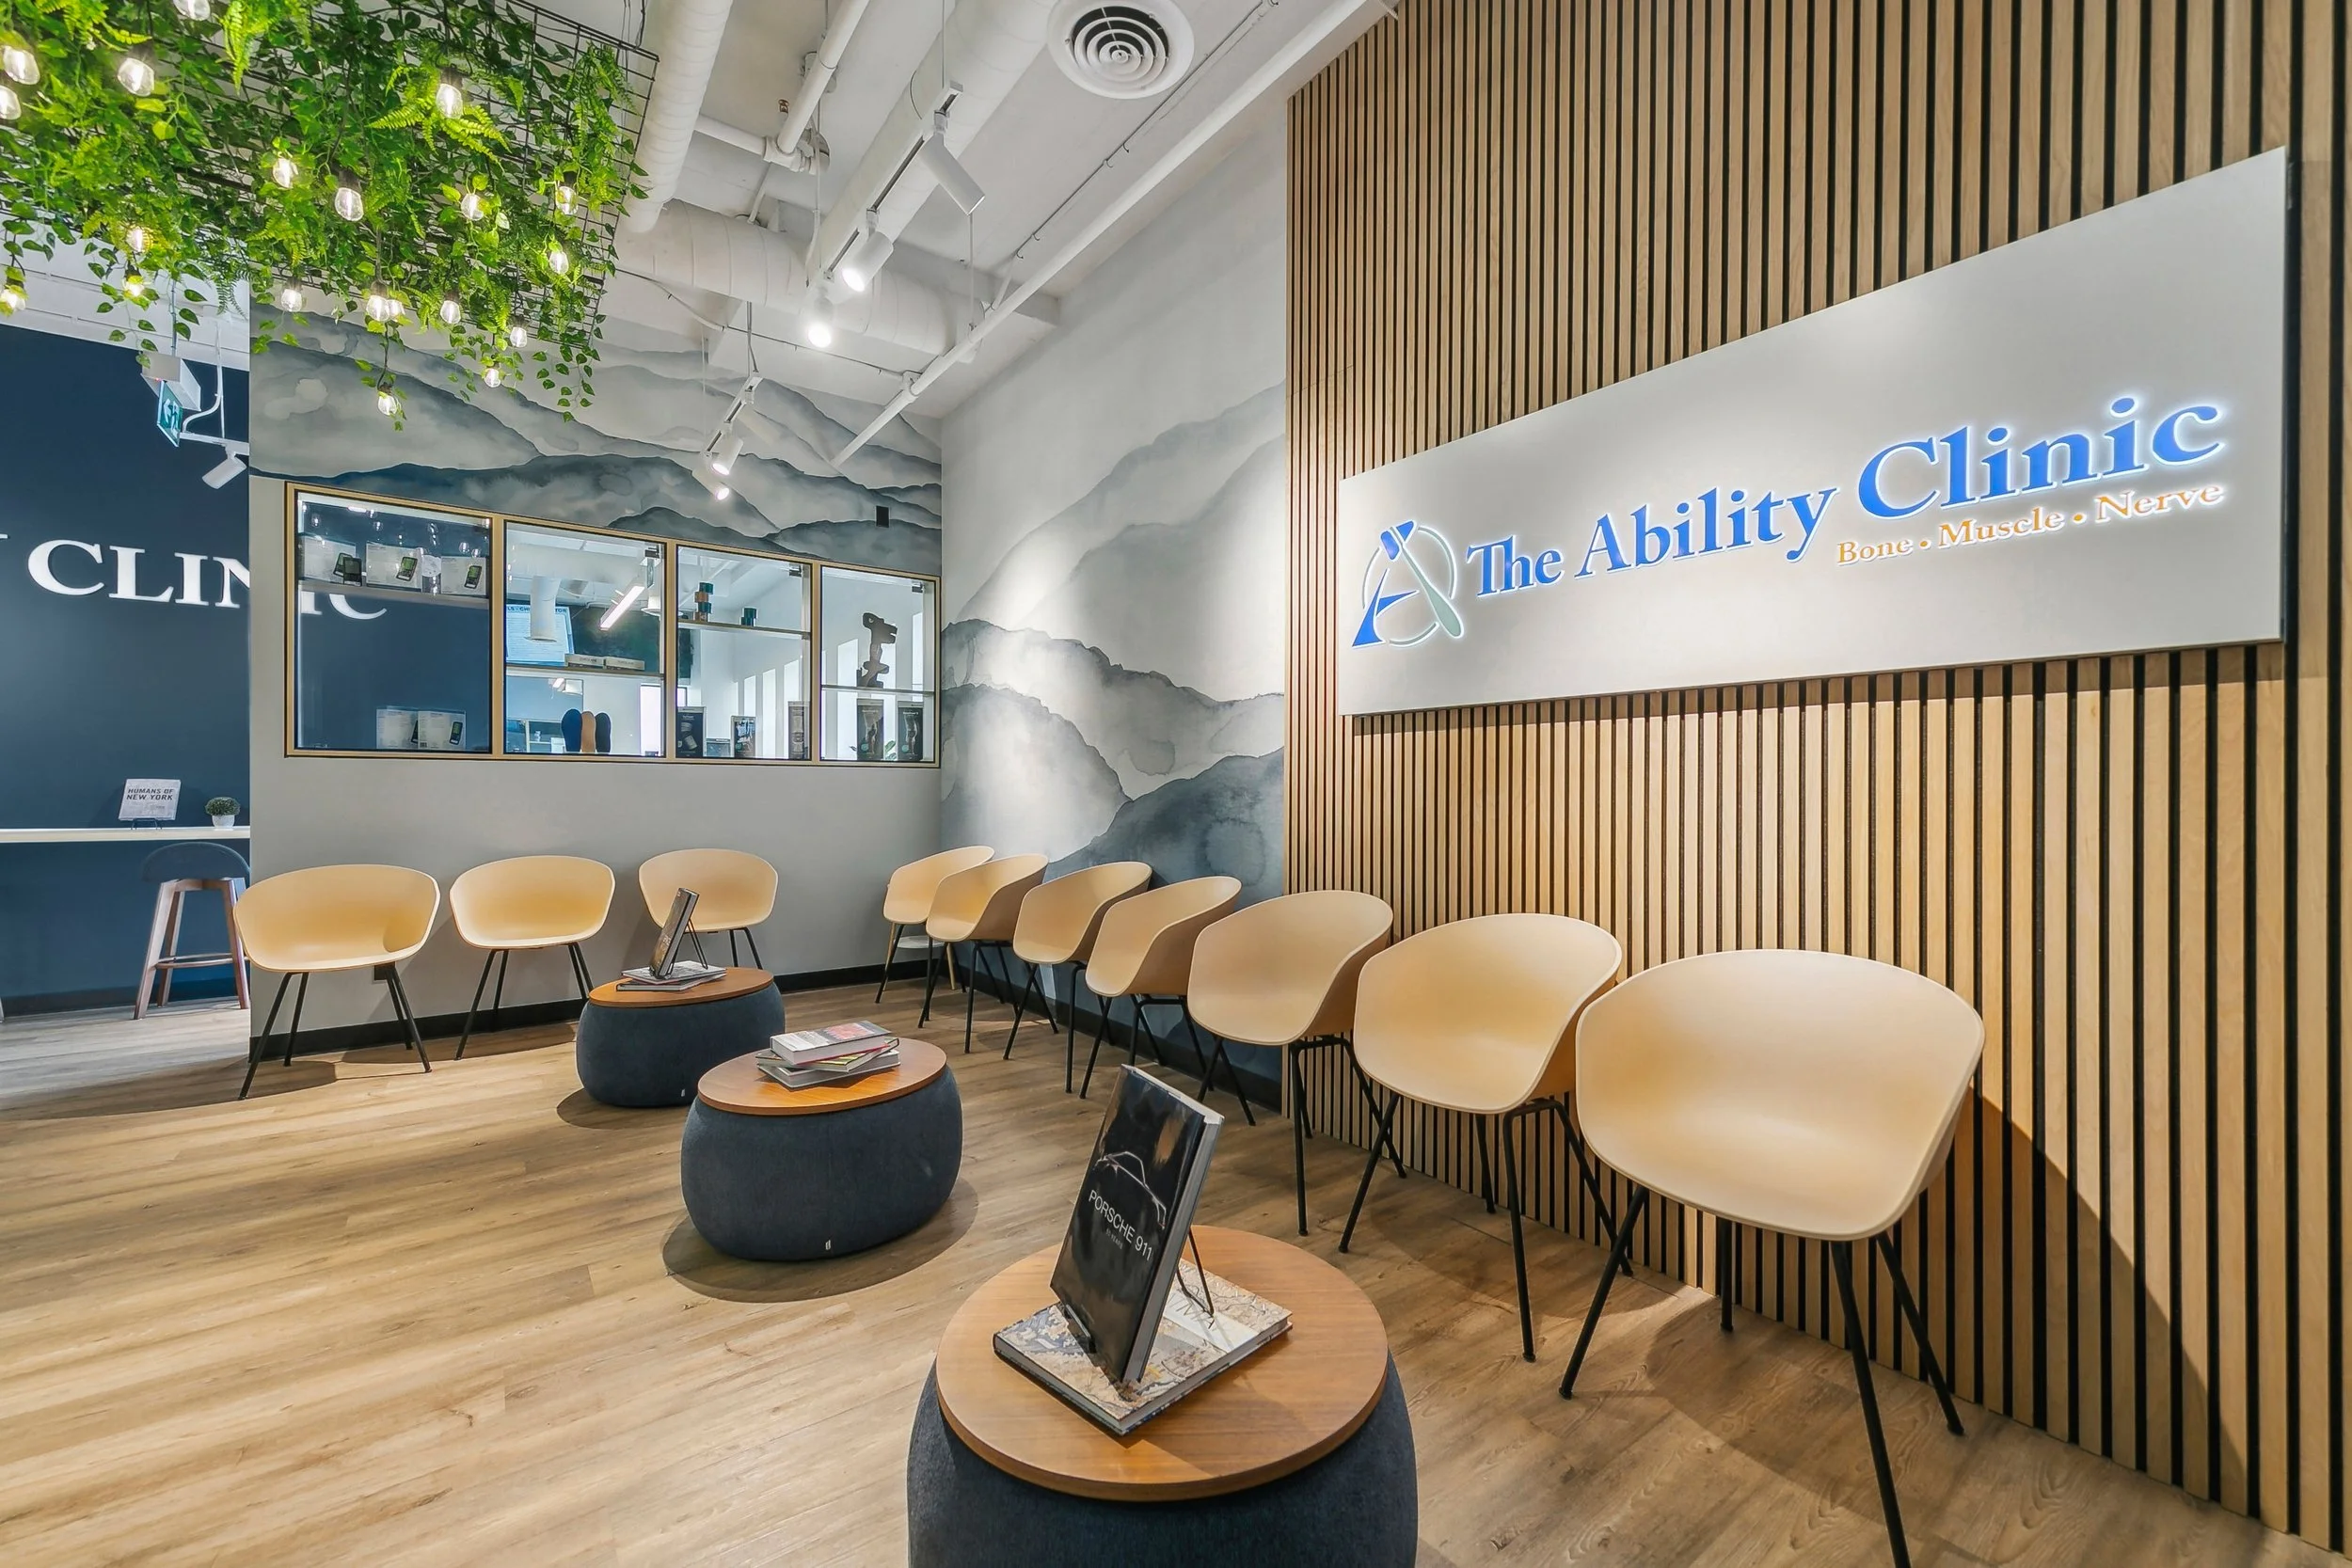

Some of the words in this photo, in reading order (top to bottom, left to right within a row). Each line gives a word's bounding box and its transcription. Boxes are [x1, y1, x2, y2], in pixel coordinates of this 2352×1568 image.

[1466, 535, 1564, 596] The
[1575, 487, 1838, 578] Ability
[1857, 397, 2220, 519] Clinic
[1837, 538, 1913, 564] Bone
[1938, 507, 2063, 548] Muscle
[2095, 483, 2225, 523] Nerve
[1089, 1189, 1136, 1243] PORSCHE
[1135, 1235, 1152, 1261] 911
